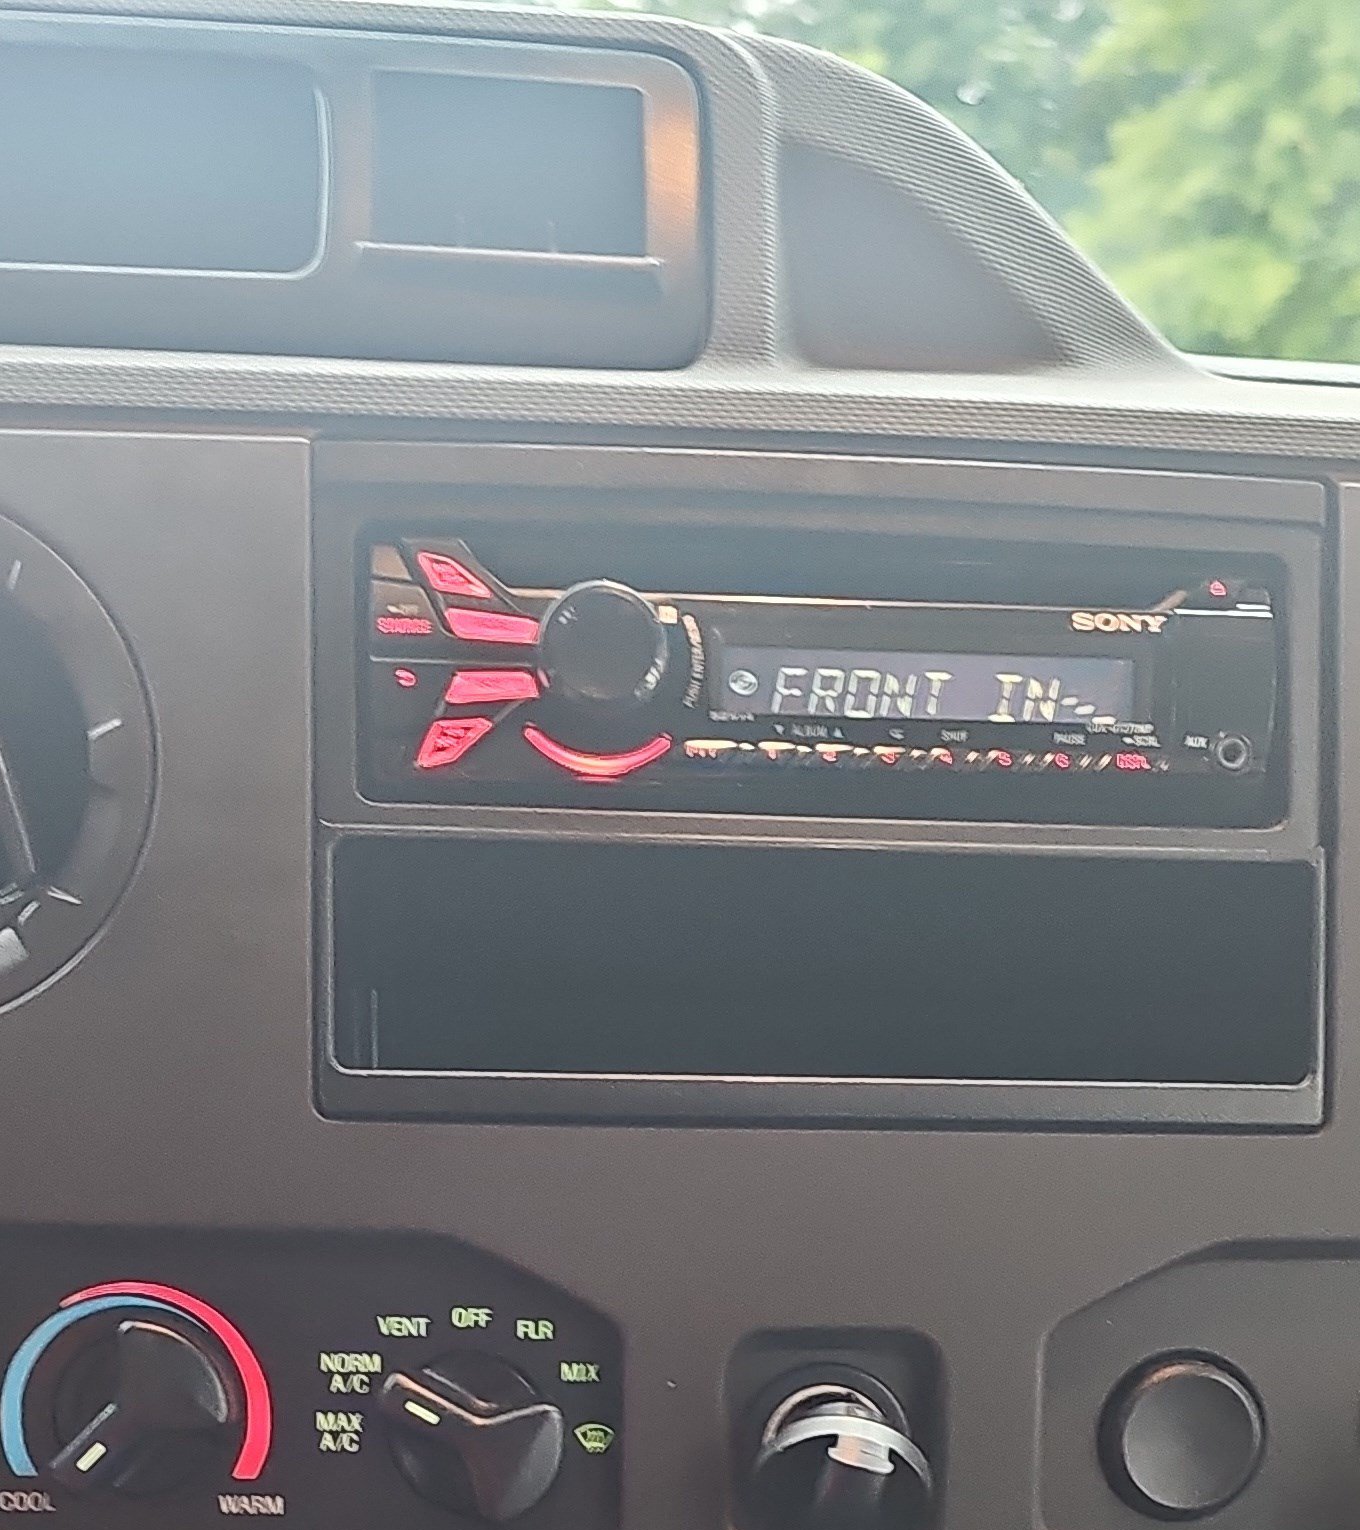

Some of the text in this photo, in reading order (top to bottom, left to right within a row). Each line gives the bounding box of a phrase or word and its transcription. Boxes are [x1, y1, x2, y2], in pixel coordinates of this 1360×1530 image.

[1071, 612, 1168, 634] SONY
[770, 667, 953, 719] FRONT
[377, 1315, 432, 1338] VENT
[451, 1306, 493, 1329] OFF
[516, 1318, 555, 1340] FLR
[319, 1352, 382, 1374] NORM
[560, 1361, 601, 1383] MIX
[328, 1373, 371, 1395] A/C
[315, 1411, 365, 1433] MAX
[319, 1432, 360, 1453] A/C
[217, 1494, 285, 1515] WARM
